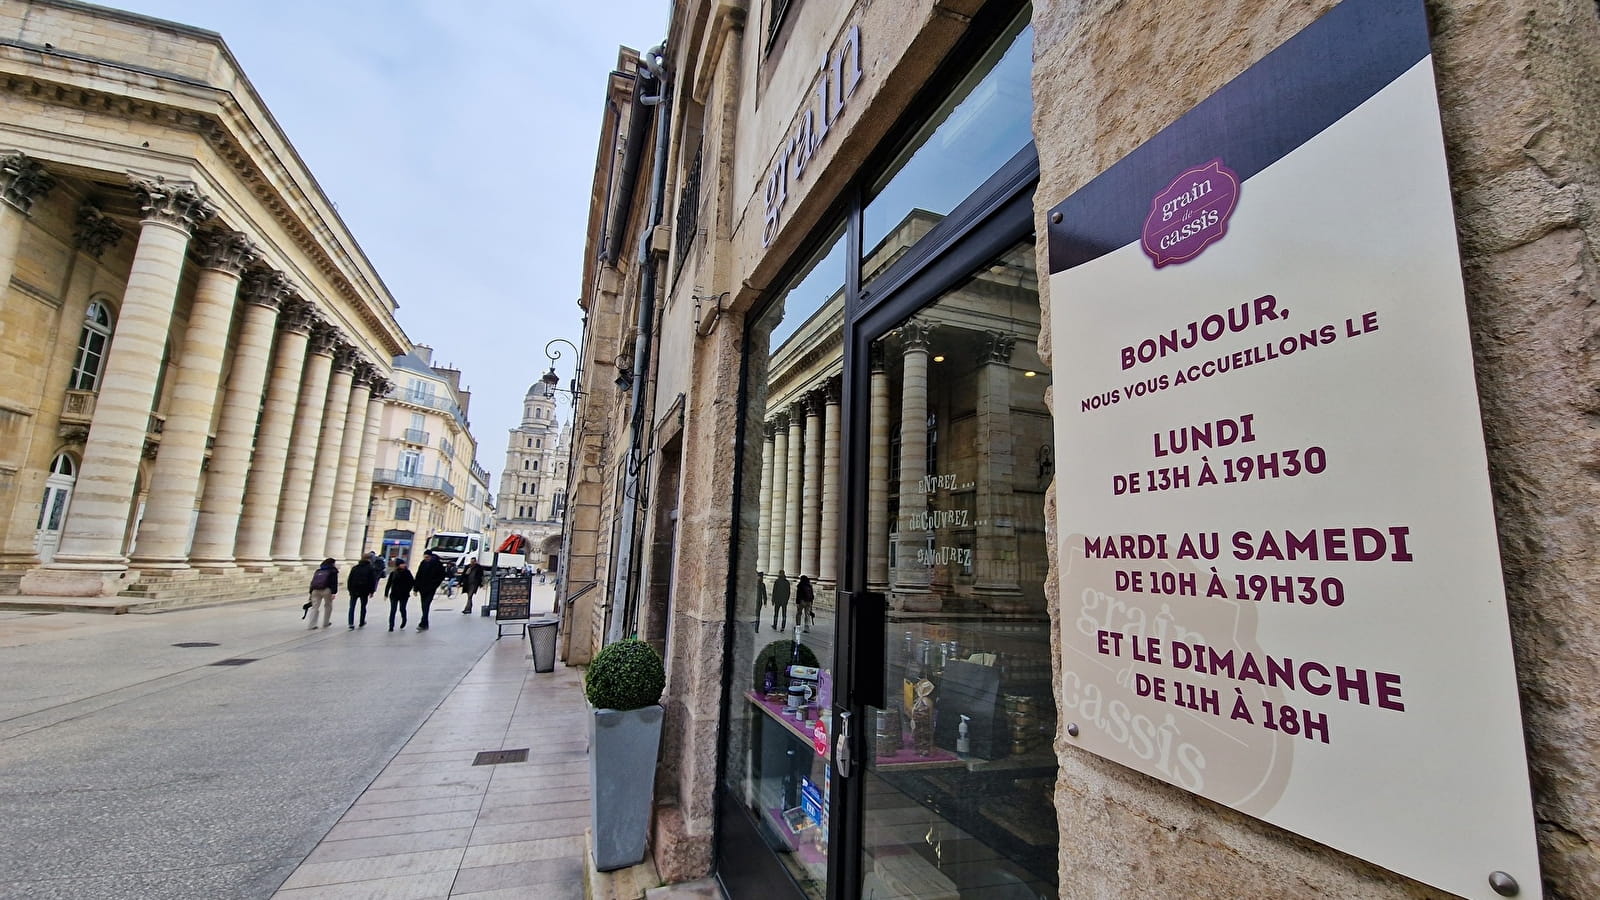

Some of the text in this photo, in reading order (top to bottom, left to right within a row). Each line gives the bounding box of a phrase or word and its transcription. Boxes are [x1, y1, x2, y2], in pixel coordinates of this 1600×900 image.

[762, 25, 863, 248] grain
[1162, 179, 1213, 222] grain
[1182, 209, 1193, 222] de
[1160, 209, 1219, 250] cassis
[1121, 294, 1290, 371] BONJOUR,
[1081, 311, 1379, 413] NOUS VOUS ACCUEILLONS LE
[1153, 413, 1256, 458] LUNDI
[918, 474, 957, 494] ENTREZ
[1113, 446, 1327, 496] DE 13H À 19H30
[1084, 526, 1414, 563] MARDI AU SAMEDI
[1115, 566, 1345, 607] DE 10H À 19H30
[1097, 629, 1405, 713] ET LE DIMANCHE
[1063, 670, 1206, 792] cassis
[1135, 672, 1330, 745] DE 11H À 18H
